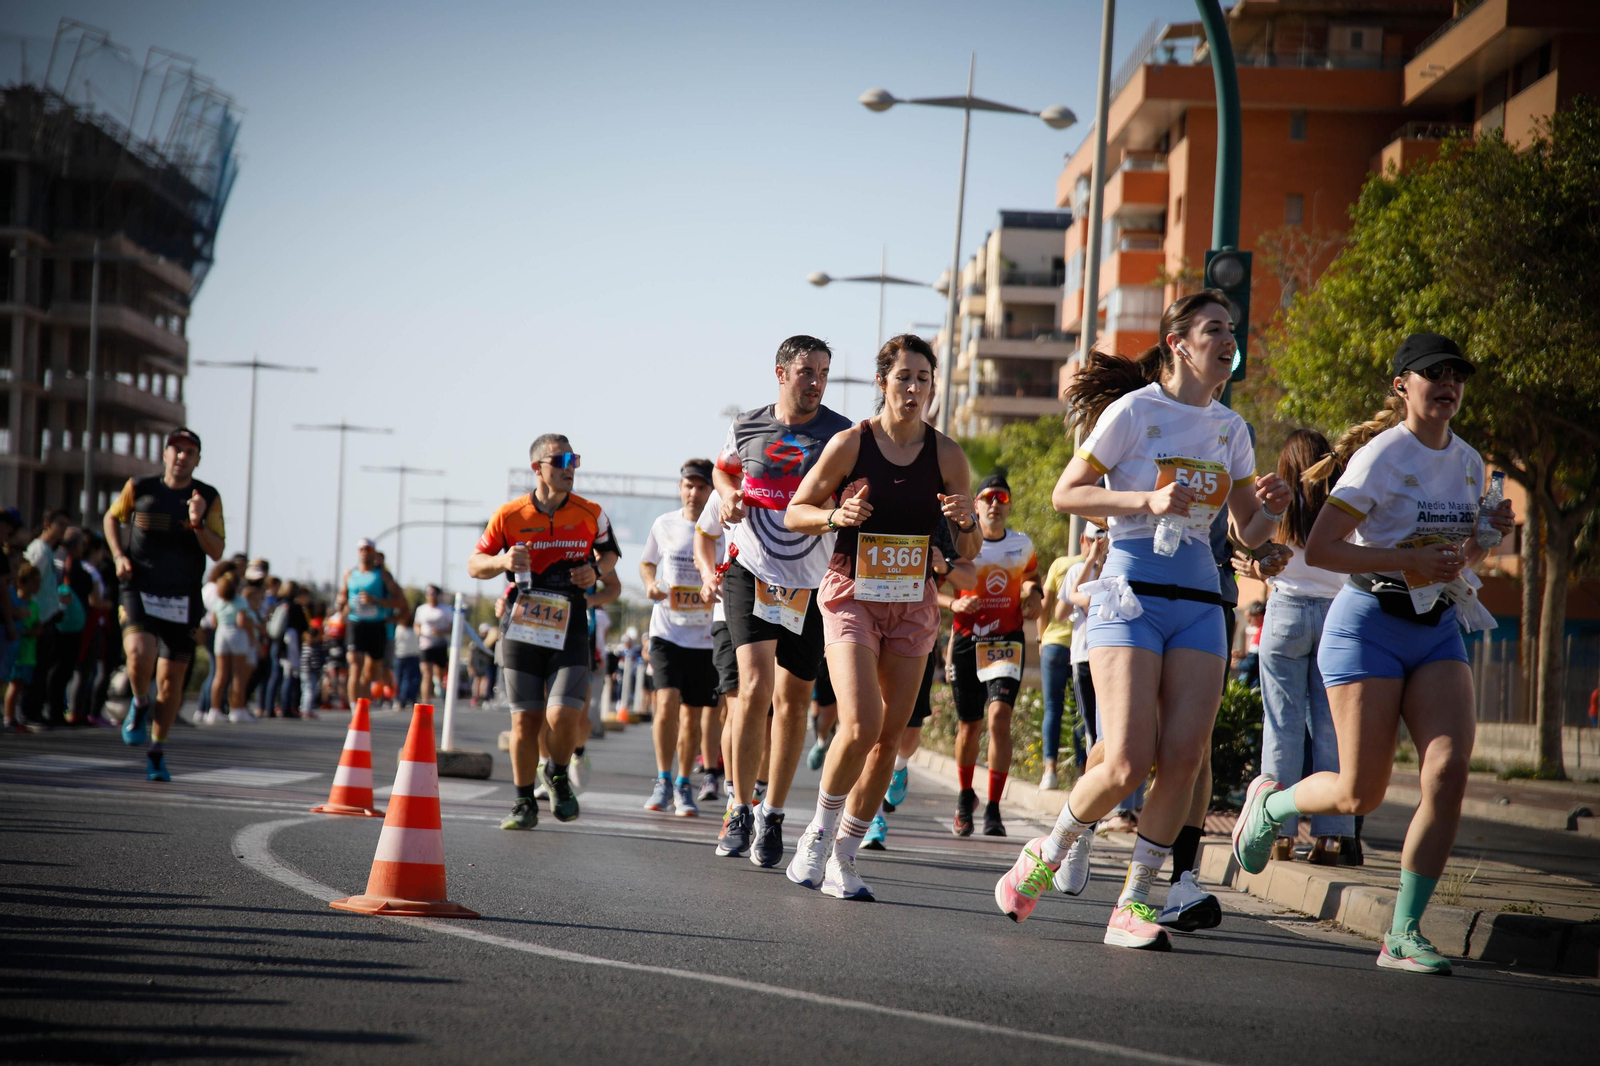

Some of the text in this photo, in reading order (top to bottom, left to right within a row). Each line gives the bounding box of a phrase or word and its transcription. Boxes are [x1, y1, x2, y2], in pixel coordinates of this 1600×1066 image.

[1175, 467, 1218, 495] 545
[747, 487, 785, 499] MEDIA
[1417, 501, 1446, 510] Medio
[1417, 511, 1475, 524] Almería 202
[530, 540, 588, 550] dipalmeria
[565, 551, 585, 559] TEAM
[866, 546, 923, 567] 1366
[521, 601, 564, 622] 1414
[986, 648, 1014, 661] 530
